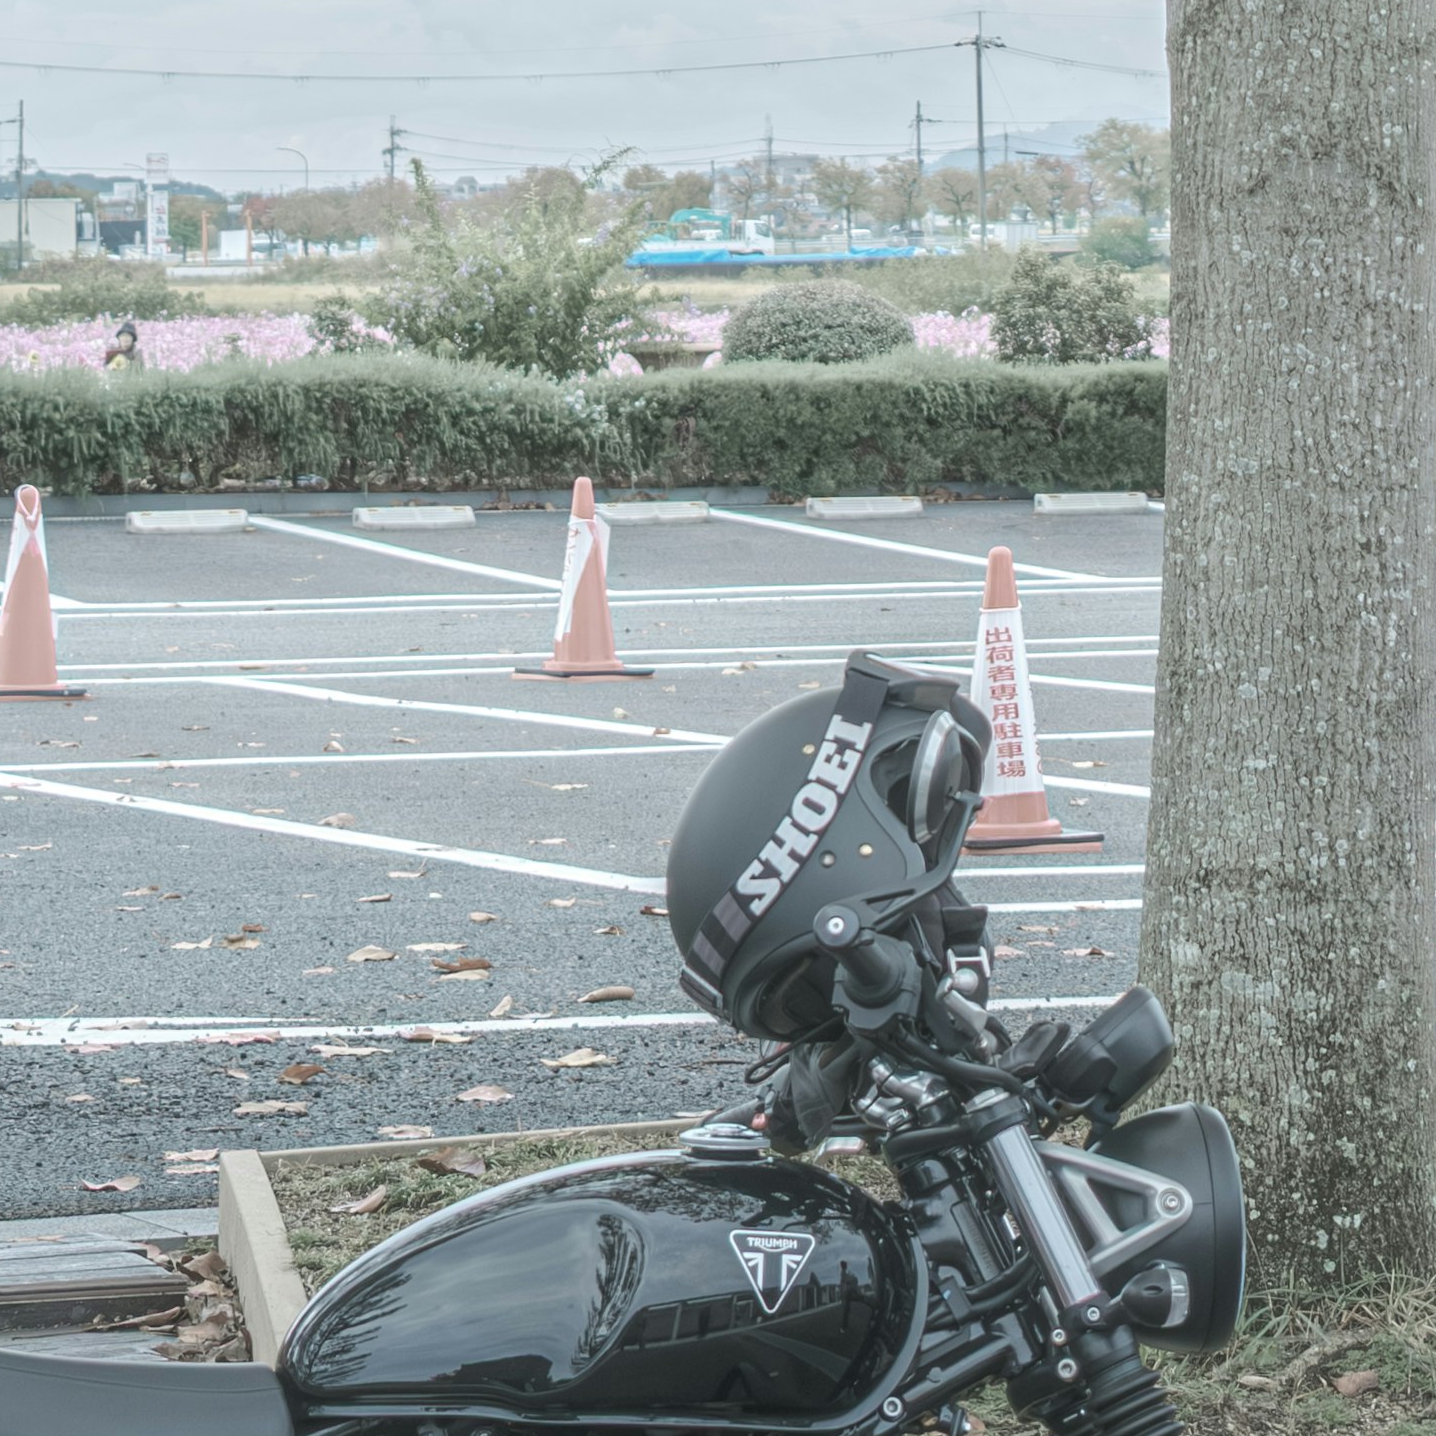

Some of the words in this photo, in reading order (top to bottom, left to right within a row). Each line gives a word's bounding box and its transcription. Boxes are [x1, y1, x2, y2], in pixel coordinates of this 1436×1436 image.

[985, 626, 1026, 777] 出荷者専用駐車場
[734, 713, 873, 917] SHOEI
[746, 1236, 798, 1250] TRIUMPH
